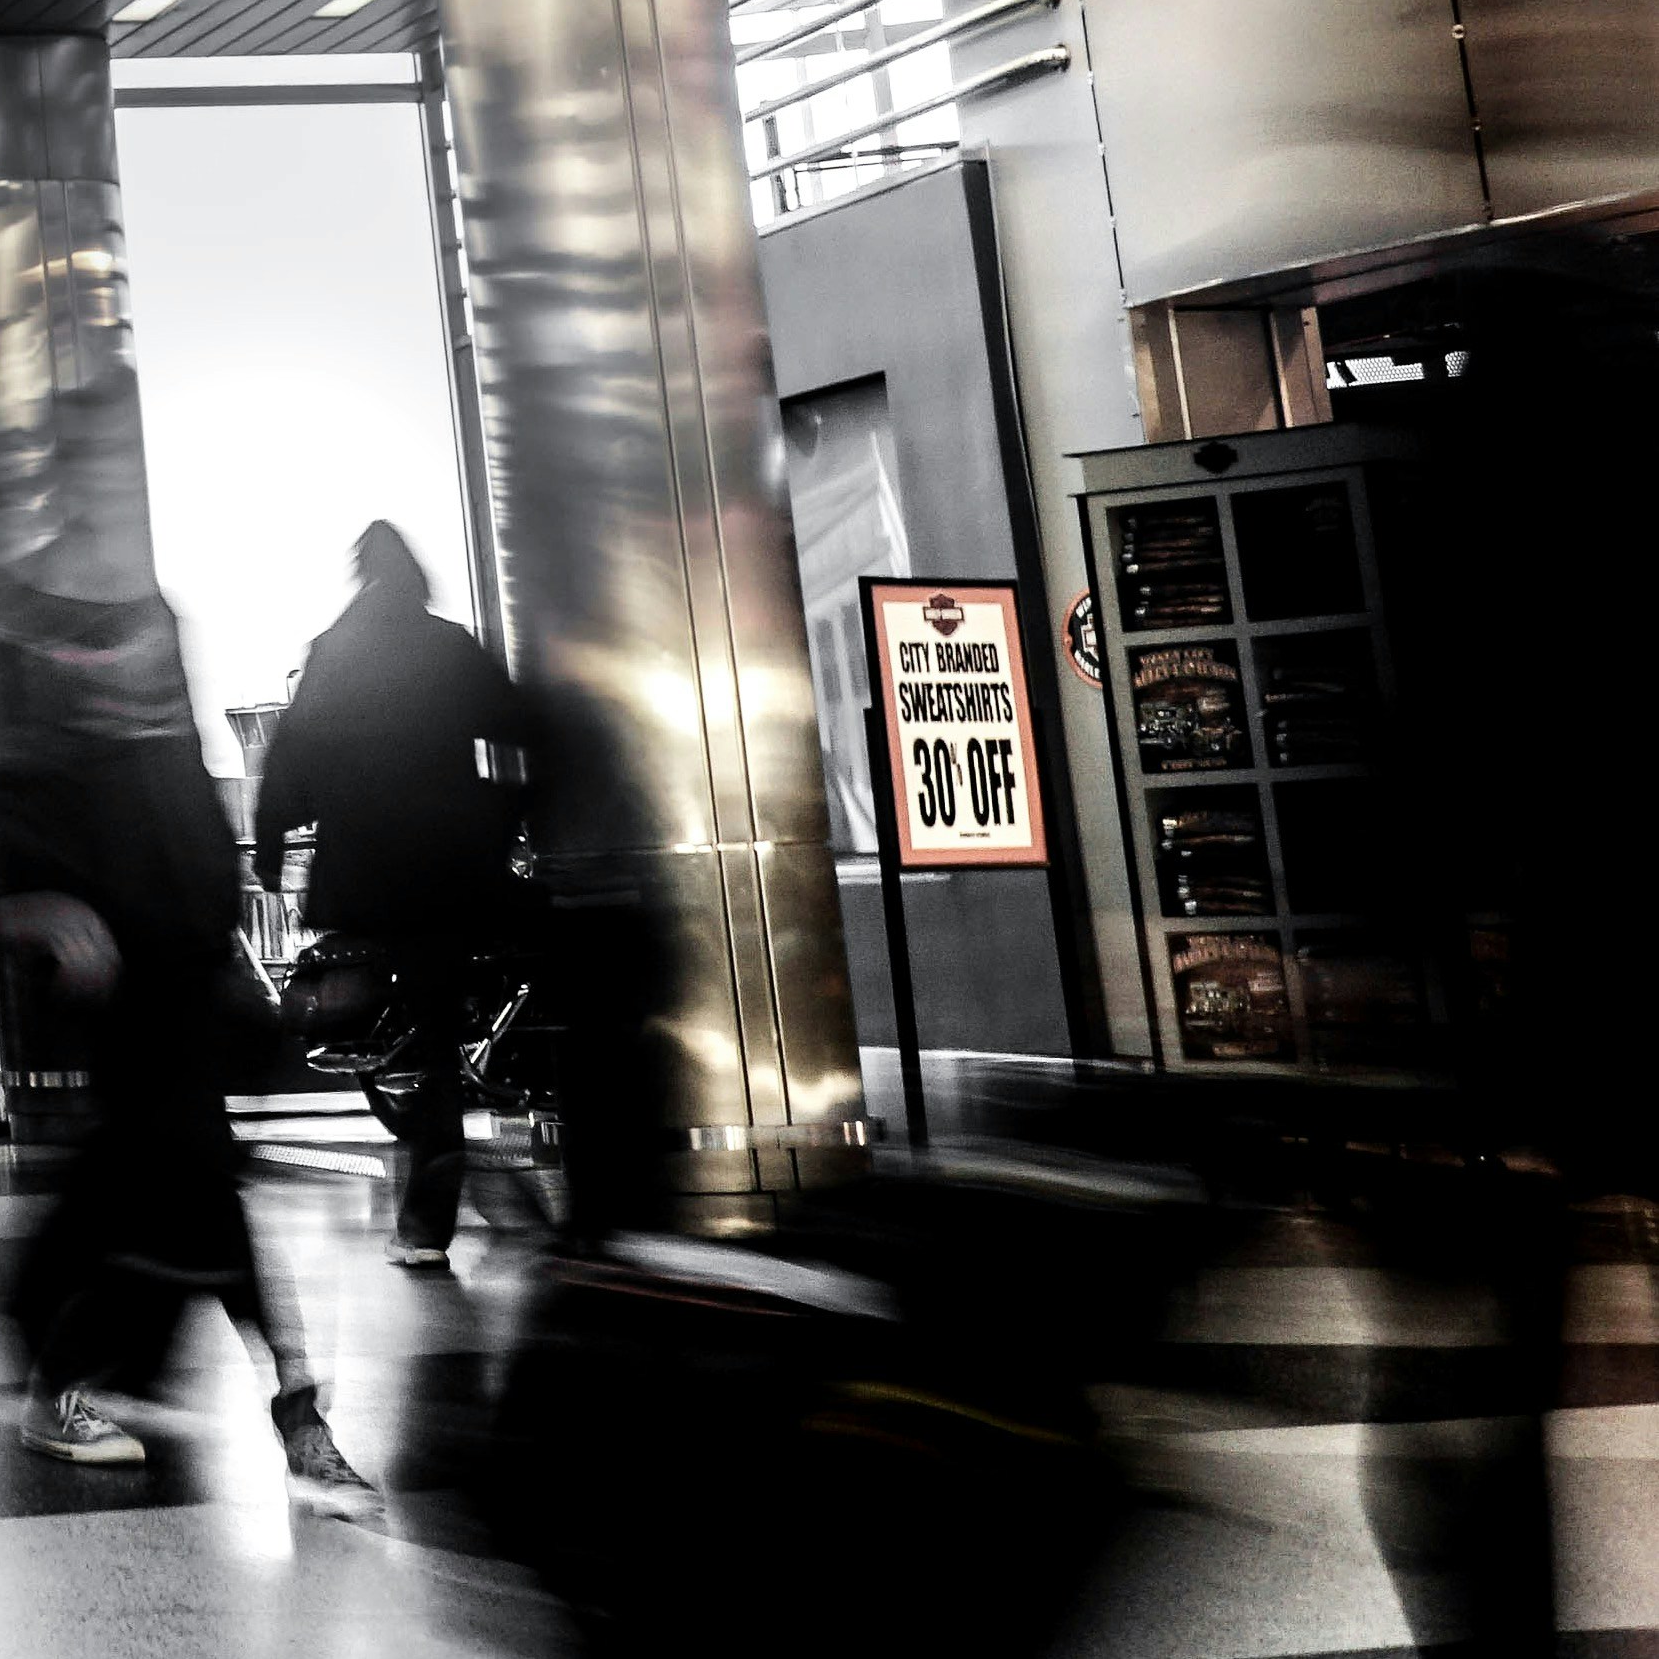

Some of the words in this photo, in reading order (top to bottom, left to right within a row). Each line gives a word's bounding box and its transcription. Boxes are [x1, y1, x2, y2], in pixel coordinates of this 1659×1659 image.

[899, 641, 930, 673] CITY
[935, 642, 999, 673] BRANDED
[899, 682, 1013, 723] SWEATSHIRTS
[967, 737, 1016, 827] OFF
